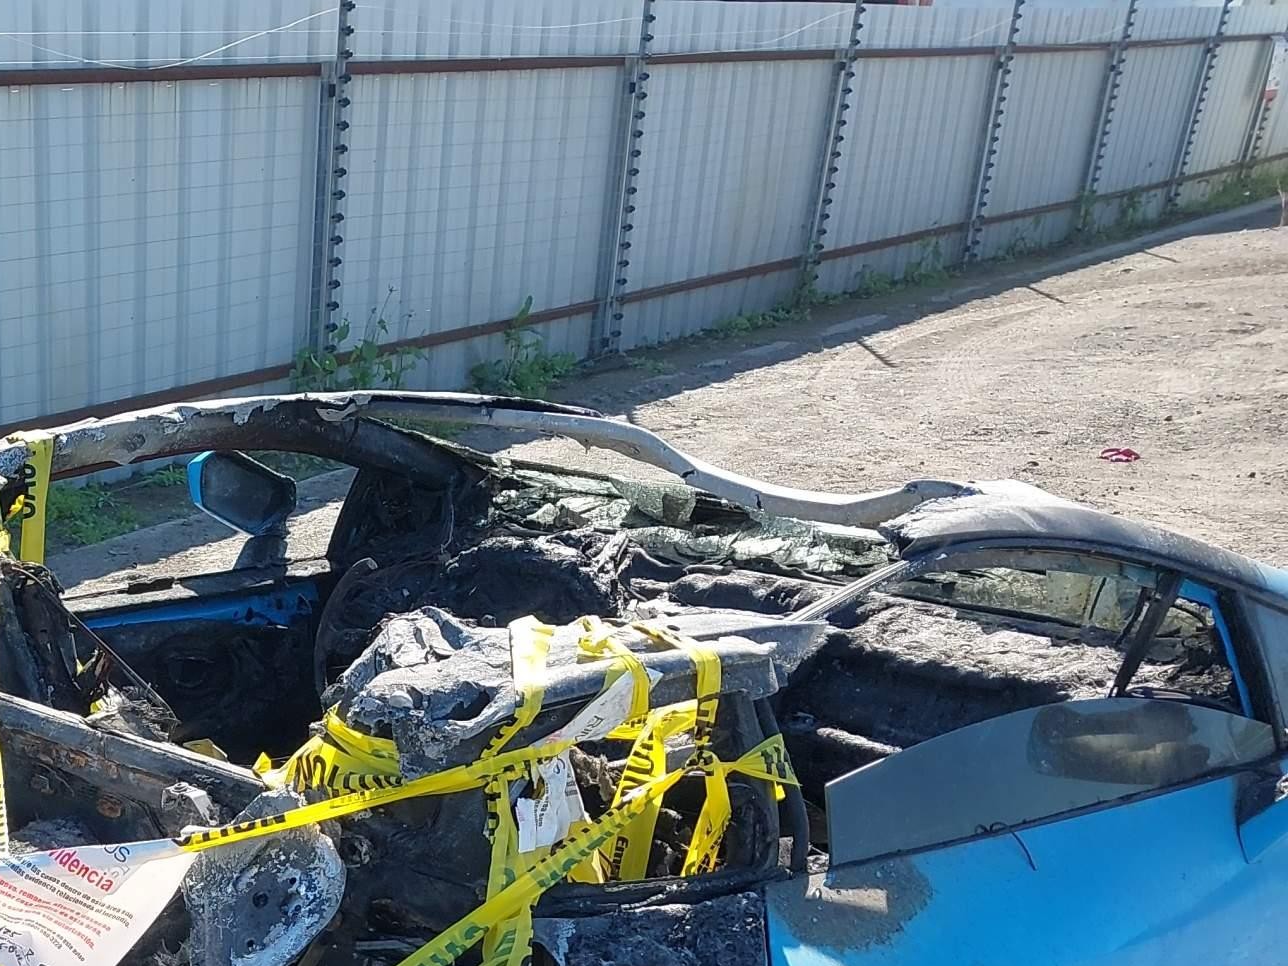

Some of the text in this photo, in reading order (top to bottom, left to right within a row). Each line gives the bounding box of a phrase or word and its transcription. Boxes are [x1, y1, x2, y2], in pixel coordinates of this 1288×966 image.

[24, 874, 57, 892] evidencia
[56, 889, 95, 911] relacionada
[31, 864, 41, 875] las
[40, 873, 60, 884] cosas
[60, 882, 82, 896] dentro
[90, 898, 106, 907] esta
